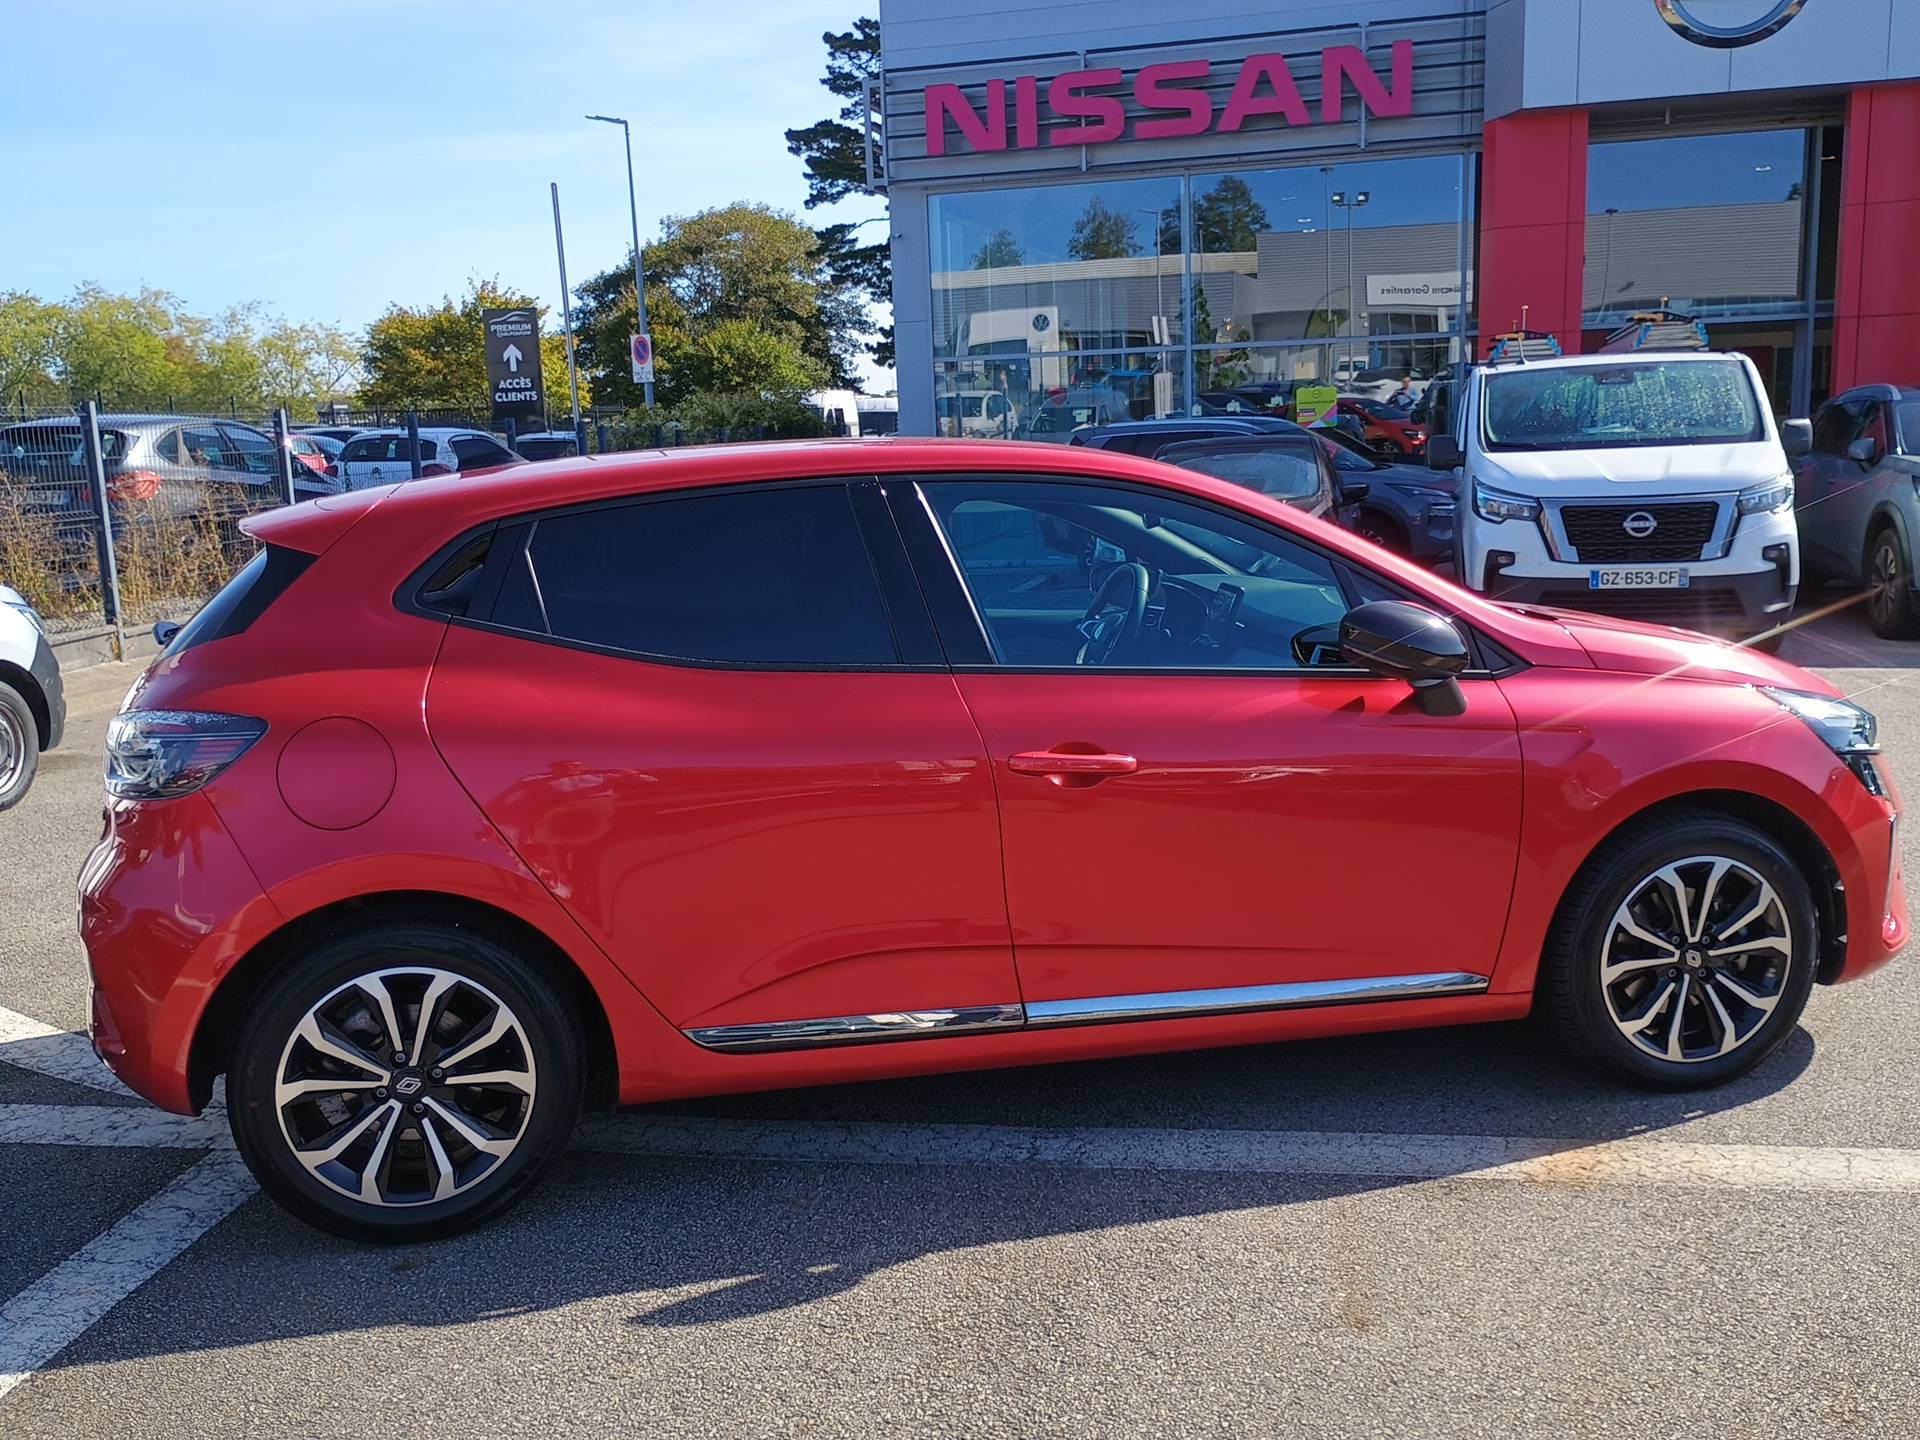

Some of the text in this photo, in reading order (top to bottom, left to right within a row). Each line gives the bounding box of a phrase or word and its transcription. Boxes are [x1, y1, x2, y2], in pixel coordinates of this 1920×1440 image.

[924, 38, 1413, 156] NISSAN
[490, 323, 532, 332] PREMIUM
[499, 376, 532, 388] ACCÈS
[494, 390, 538, 402] CLIENTS
[1601, 571, 1678, 585] GZ-653-CF
